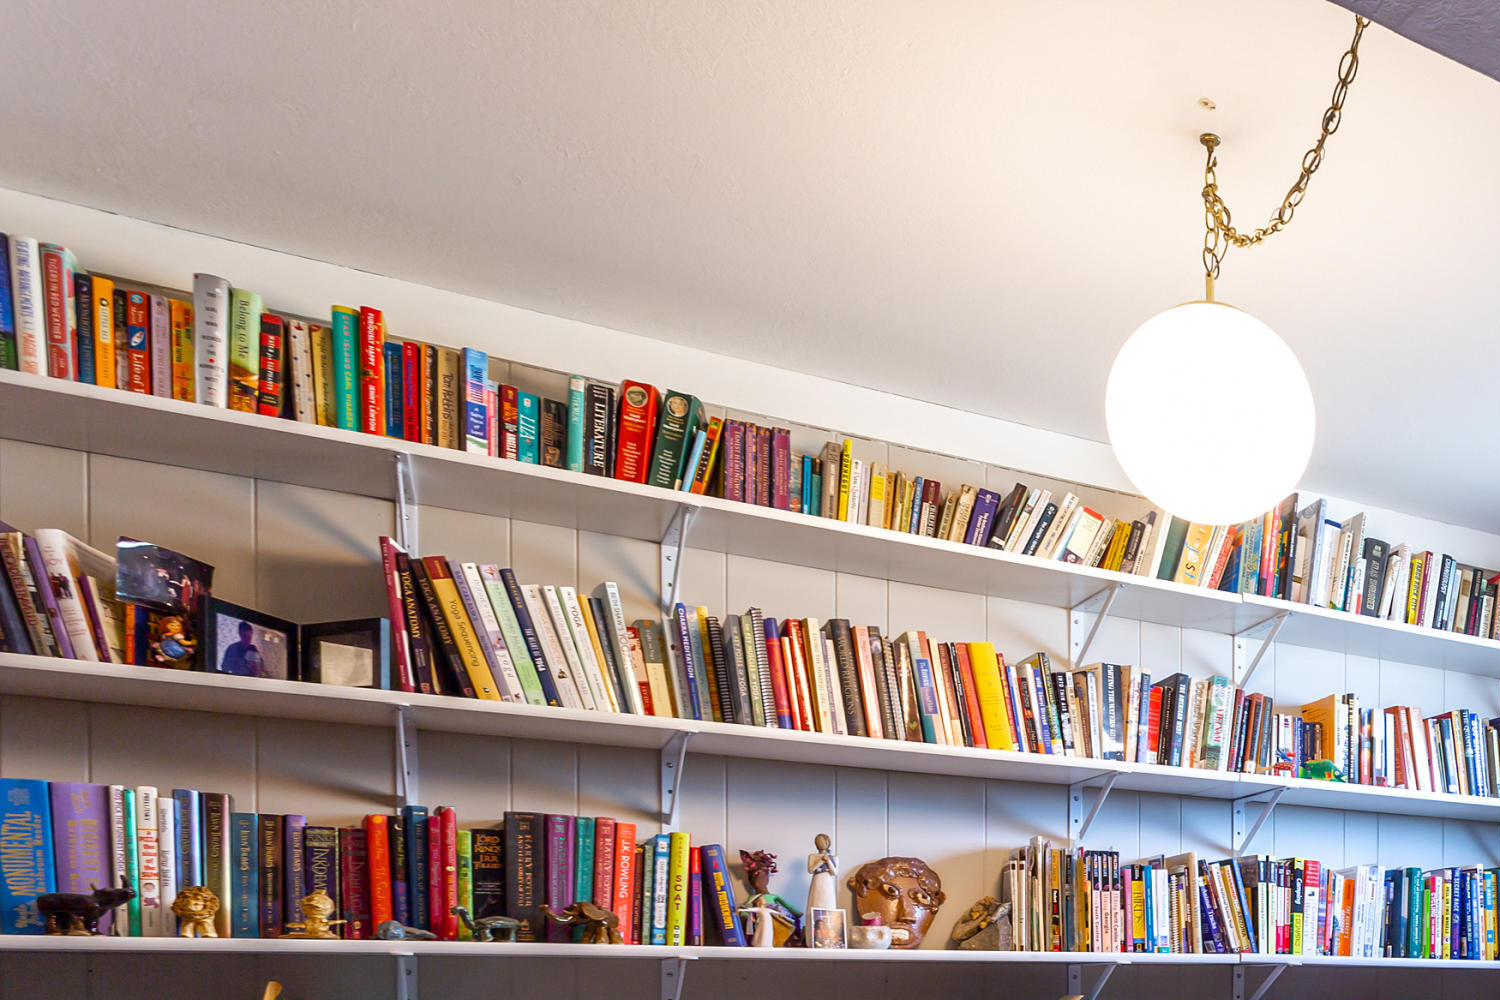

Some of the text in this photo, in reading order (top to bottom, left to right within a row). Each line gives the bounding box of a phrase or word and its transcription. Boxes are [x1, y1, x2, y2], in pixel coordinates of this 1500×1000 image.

[47, 258, 57, 281] TIGERS
[49, 283, 58, 292] IN
[50, 293, 59, 306] RED
[51, 308, 62, 340] WEATHER
[236, 299, 250, 359] Belong to Me
[367, 313, 376, 366] FURIOUSLY HAPPY
[133, 354, 144, 387] Life of
[266, 335, 275, 391] WATER ELEPHANTS
[343, 339, 351, 369] ISLAND
[368, 405, 376, 431] LAWSON
[593, 403, 605, 468] LITERATURE
[841, 453, 850, 495] VONNEGUT
[1371, 560, 1380, 577] ATLAS
[1440, 558, 1452, 594] CHANGEOLOGY
[401, 571, 421, 639] YOGA ANATOMY
[1410, 562, 1423, 612] FARGO ROCK CITY
[418, 577, 453, 645] YOGA ANATOMY
[570, 606, 583, 628] YOGA
[448, 599, 481, 667] Yoga Sequencing
[678, 608, 694, 678] CHAKRA MEDITATION
[738, 677, 746, 697] YOGA
[751, 681, 759, 701] YOGA
[1176, 695, 1185, 720] AMERICAN
[0, 811, 37, 896] MONUMENTAL
[81, 819, 100, 872] BIGGEST
[603, 838, 611, 871] HARRY
[618, 839, 630, 898] J.K. ROWLING
[673, 874, 683, 911] SCAT
